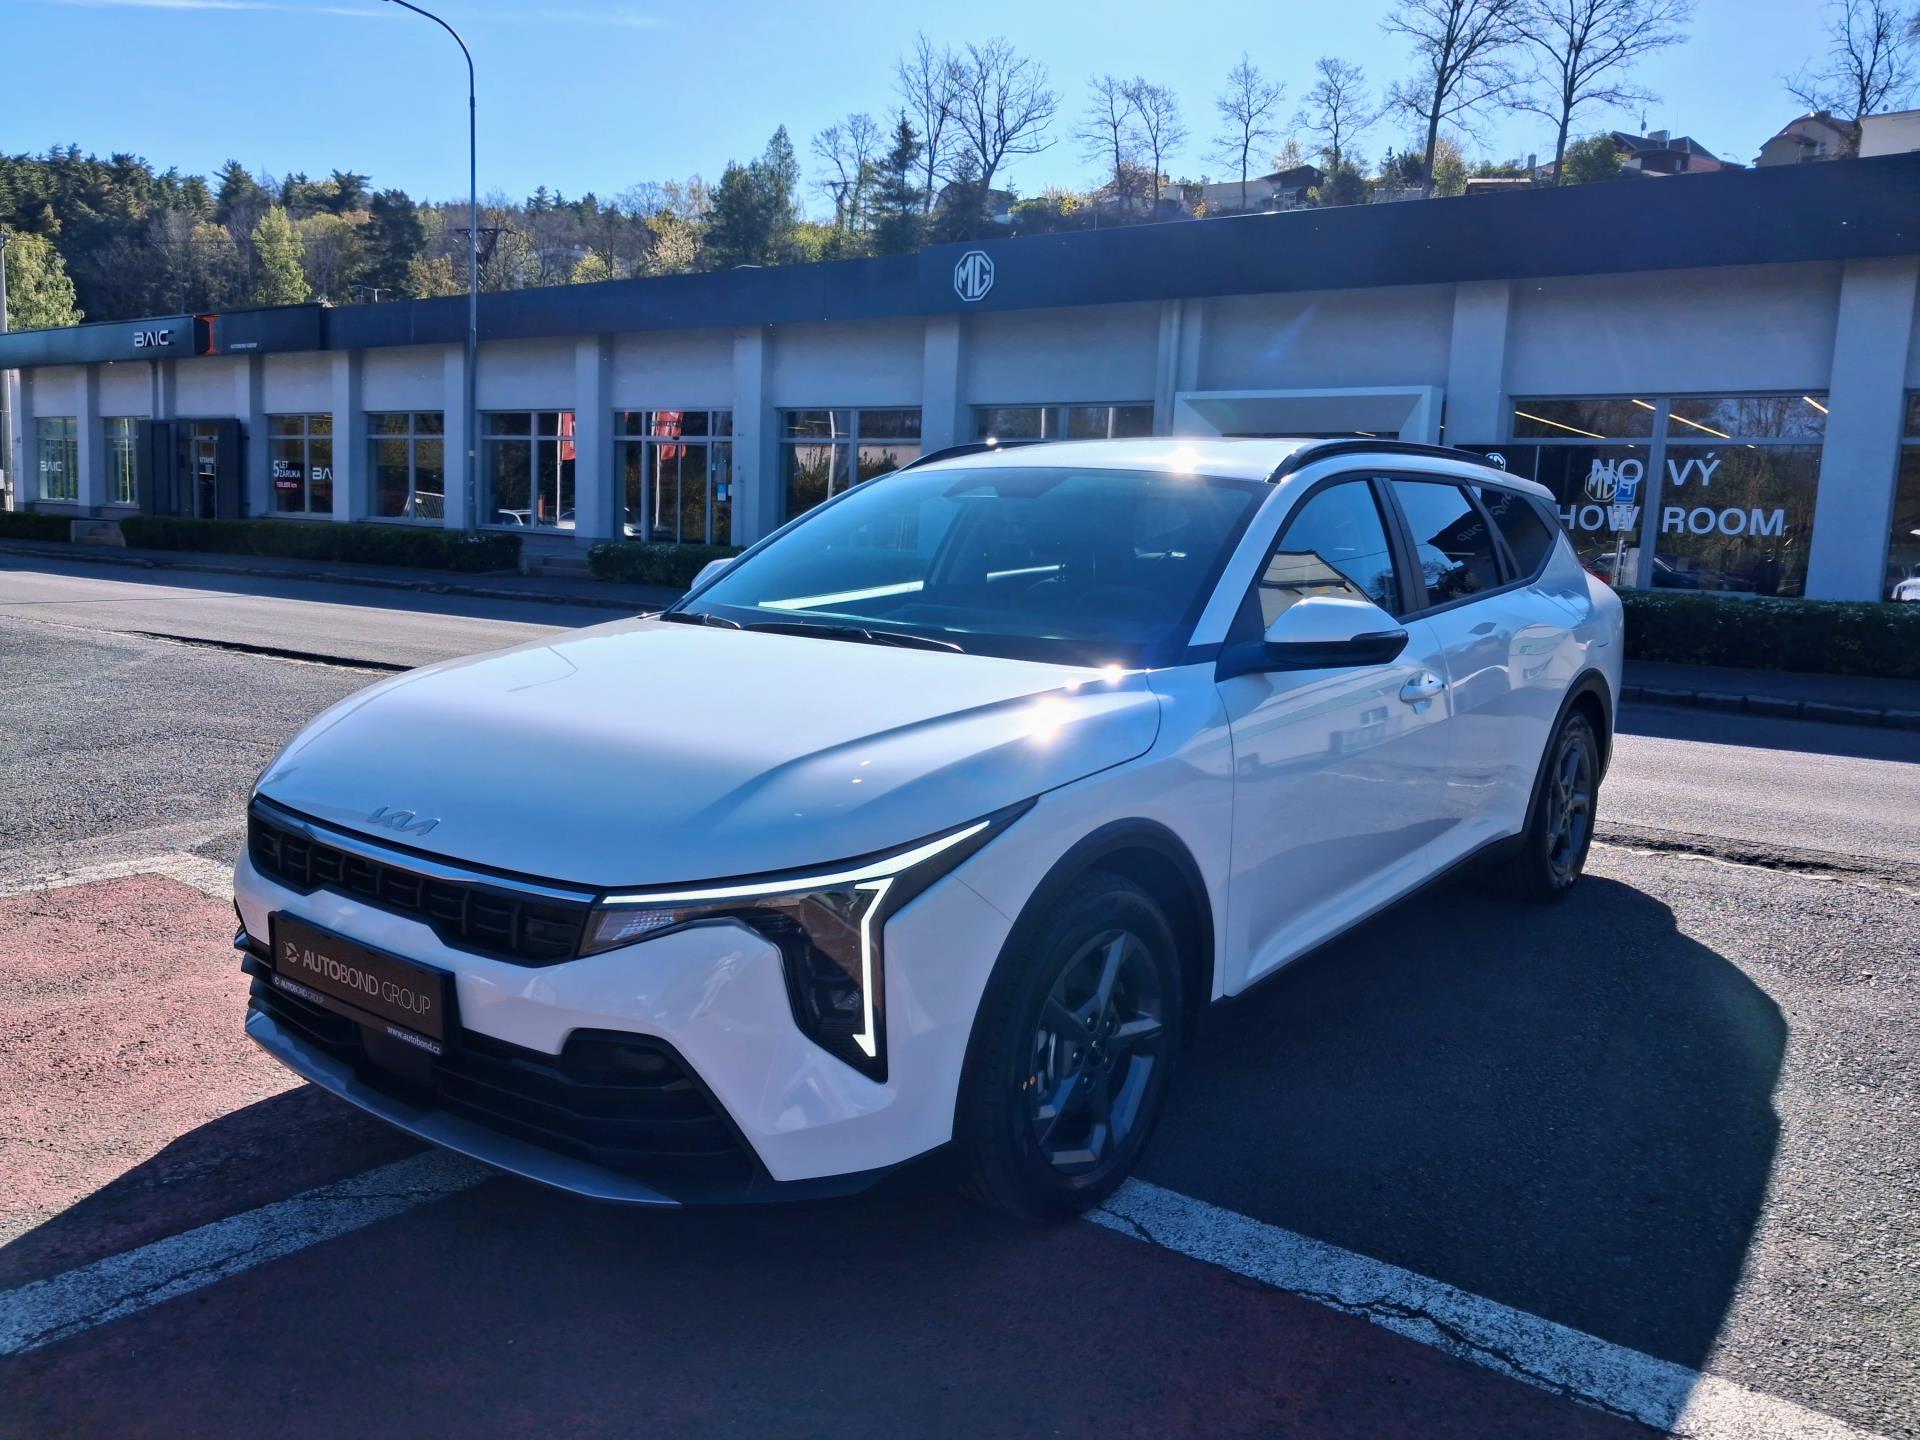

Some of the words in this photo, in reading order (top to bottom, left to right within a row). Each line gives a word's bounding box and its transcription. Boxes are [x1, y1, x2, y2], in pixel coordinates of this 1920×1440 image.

[958, 254, 991, 297] MG
[134, 330, 169, 347] BAIC
[40, 461, 63, 471] BAIC
[273, 460, 280, 477] 5
[280, 461, 288, 469] LET
[312, 467, 333, 480] BA
[1591, 459, 1643, 486] NO
[1667, 452, 1720, 486] VÝ
[1555, 504, 1640, 531] HOW
[1662, 507, 1785, 536] ROOM
[303, 949, 379, 996] AUTOBOND
[382, 981, 431, 1015] GROUP
[386, 1025, 441, 1055] www.autobond.cz
